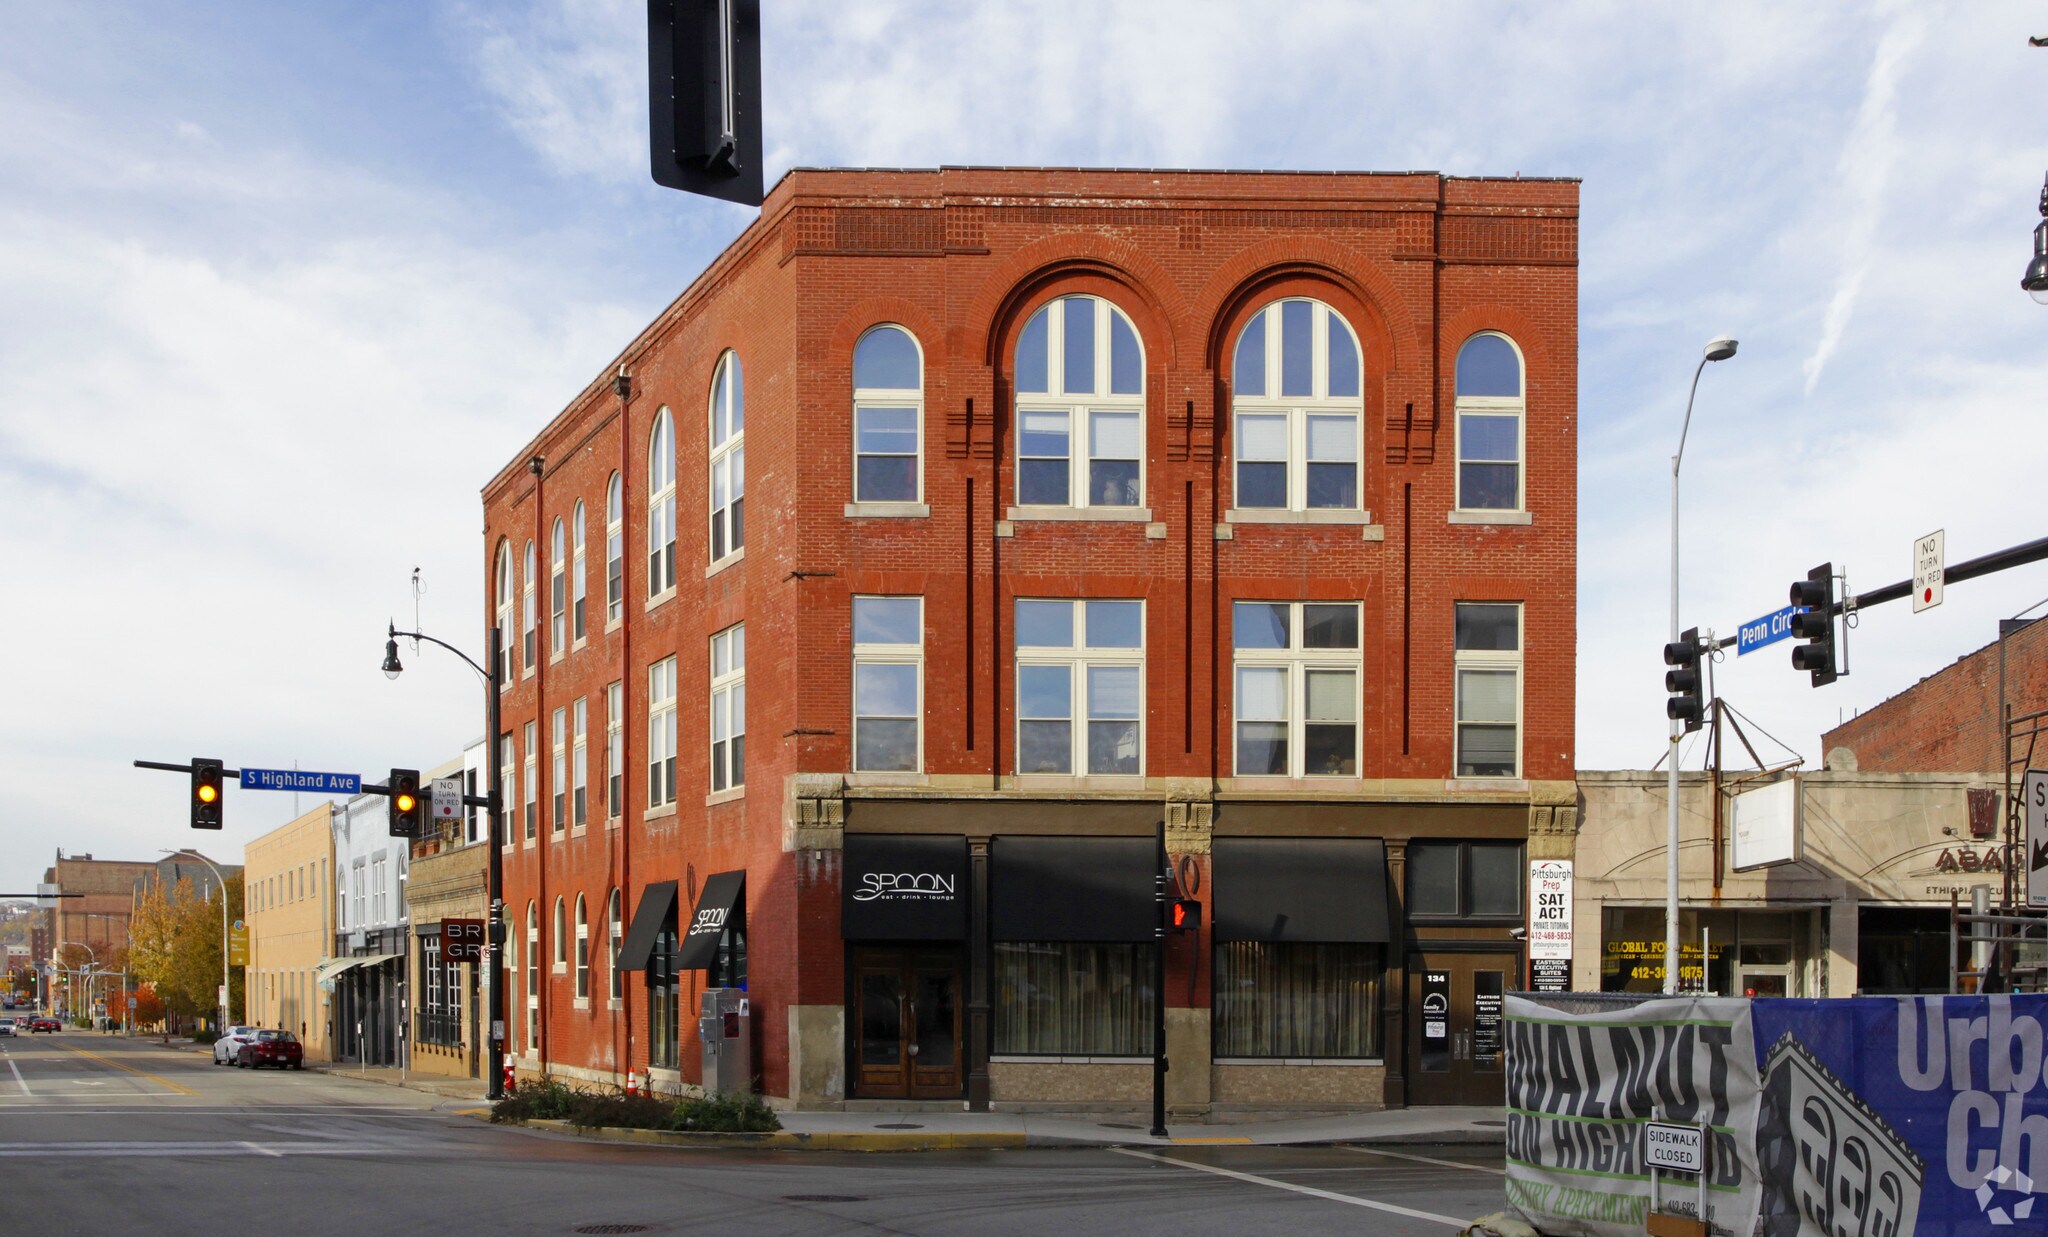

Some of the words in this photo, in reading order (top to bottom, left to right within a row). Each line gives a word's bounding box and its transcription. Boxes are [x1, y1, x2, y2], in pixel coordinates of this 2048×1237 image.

[1922, 538, 1936, 556] NO
[1920, 555, 1938, 571] TURN
[1915, 576, 1925, 589] ON
[1927, 569, 1942, 585] RED
[1742, 622, 1768, 647] Penn
[248, 771, 256, 785] S
[261, 772, 324, 789] Highland
[329, 776, 355, 789] Ave
[440, 782, 454, 790] NO
[1531, 869, 1572, 881] Pittsburgh
[862, 873, 954, 894] SPOON
[1542, 880, 1560, 891] Prep
[1538, 893, 1565, 906] SAT
[1538, 907, 1566, 920] ACT
[447, 924, 481, 937] BR
[1533, 921, 1549, 930] PRIVATE
[1550, 921, 1569, 930] TUTORING
[1531, 931, 1572, 940] 412-468-5833
[447, 943, 481, 957] GR
[1607, 942, 1648, 953] GLOBAL
[1505, 1019, 1732, 1127] WALNUT
[1507, 1112, 1542, 1165] ON
[1649, 1130, 1698, 1147] SIDEWALK
[1654, 1148, 1693, 1163] CLOSED
